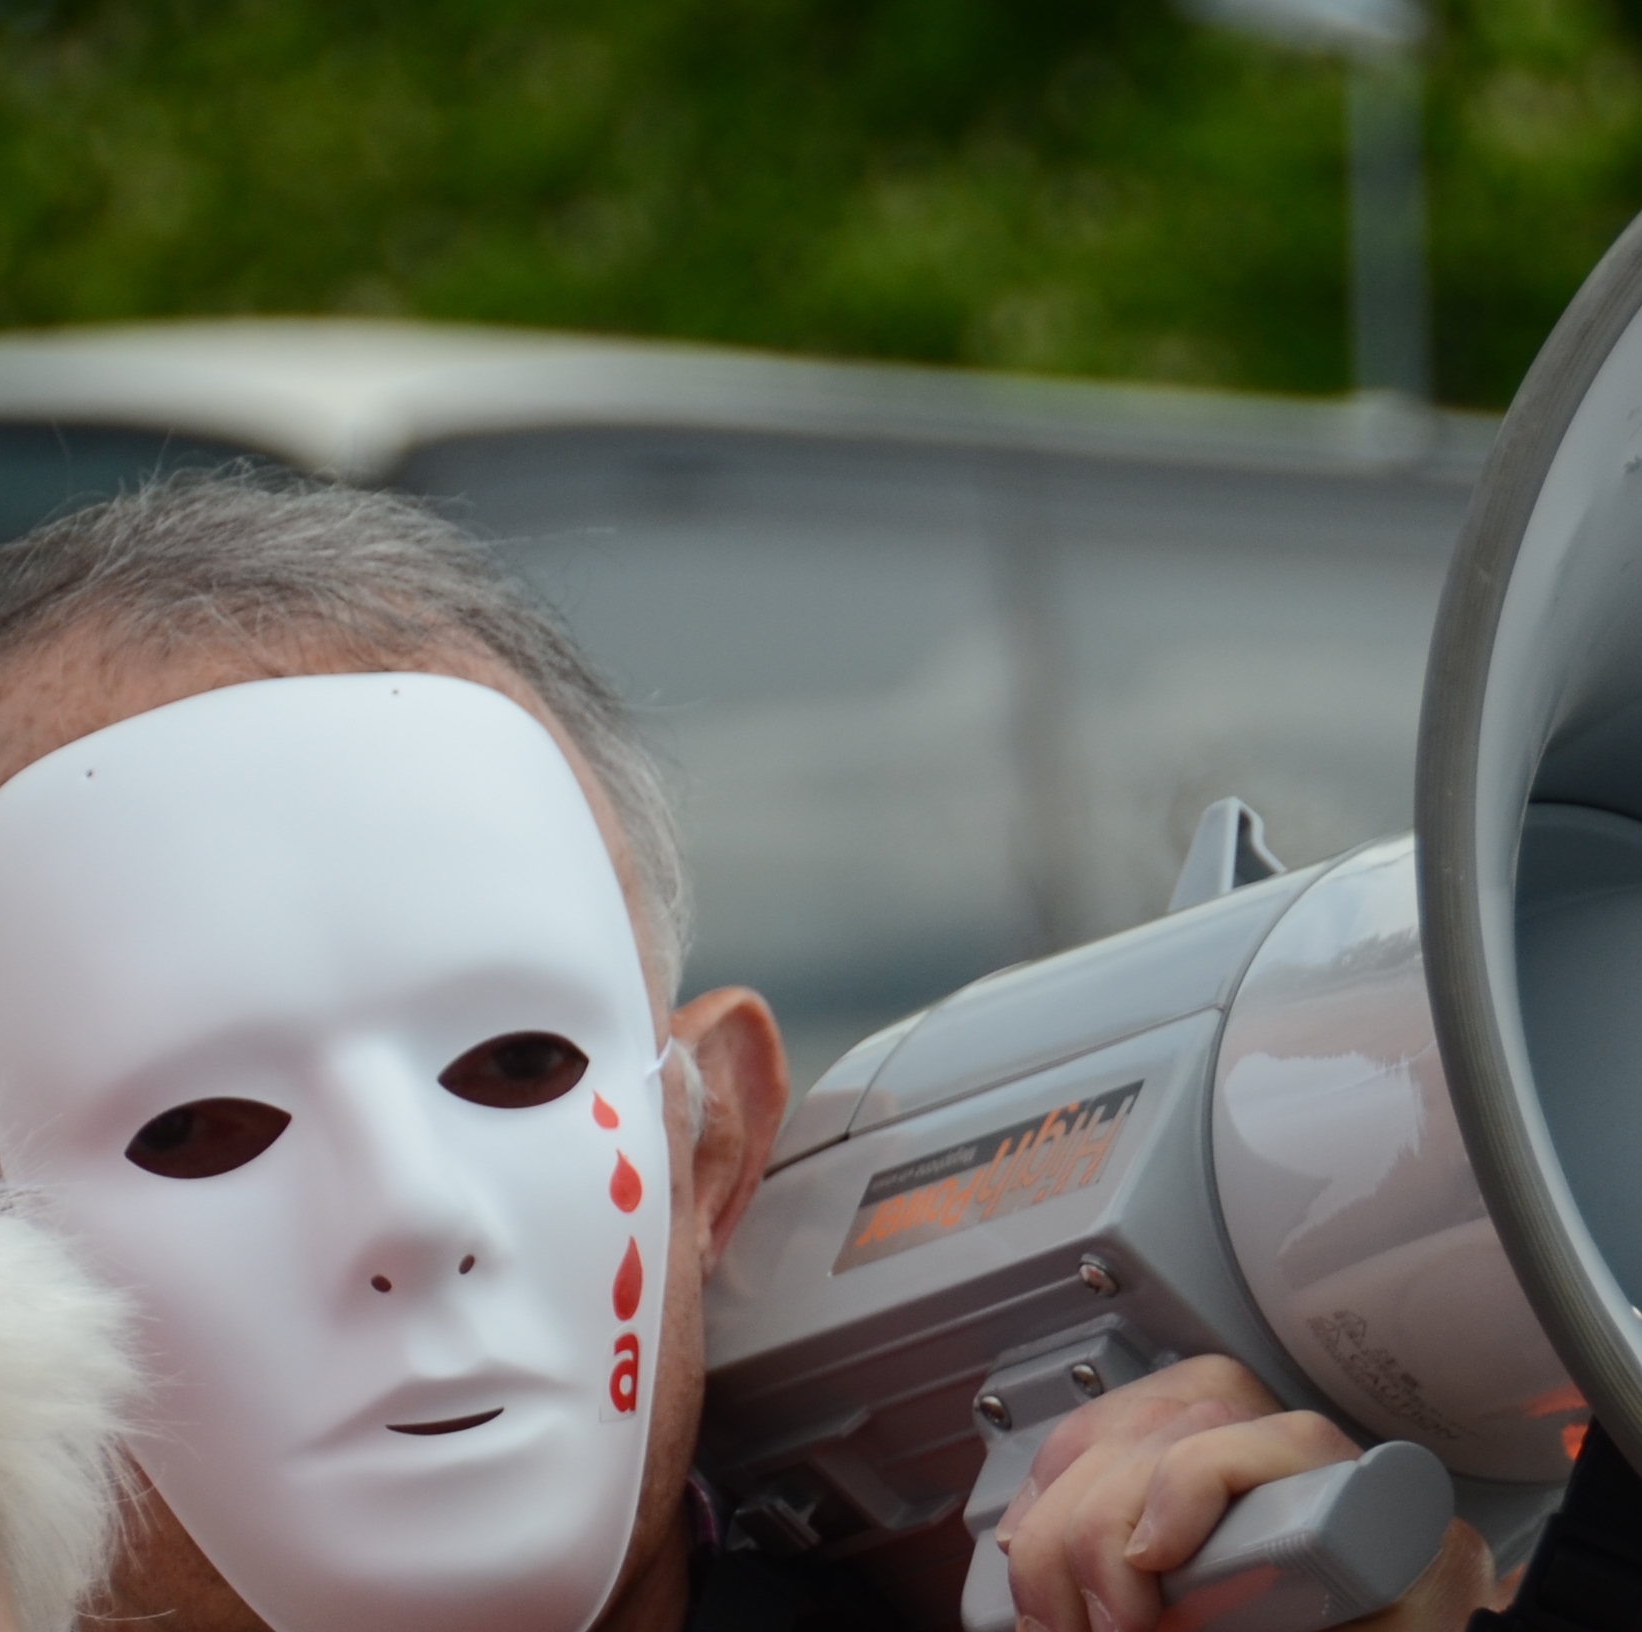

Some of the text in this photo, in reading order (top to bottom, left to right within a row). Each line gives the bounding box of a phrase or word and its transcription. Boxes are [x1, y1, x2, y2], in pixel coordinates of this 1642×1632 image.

[975, 1094, 1135, 1223] High
[856, 1166, 986, 1248] Power
[609, 1331, 640, 1413] a
